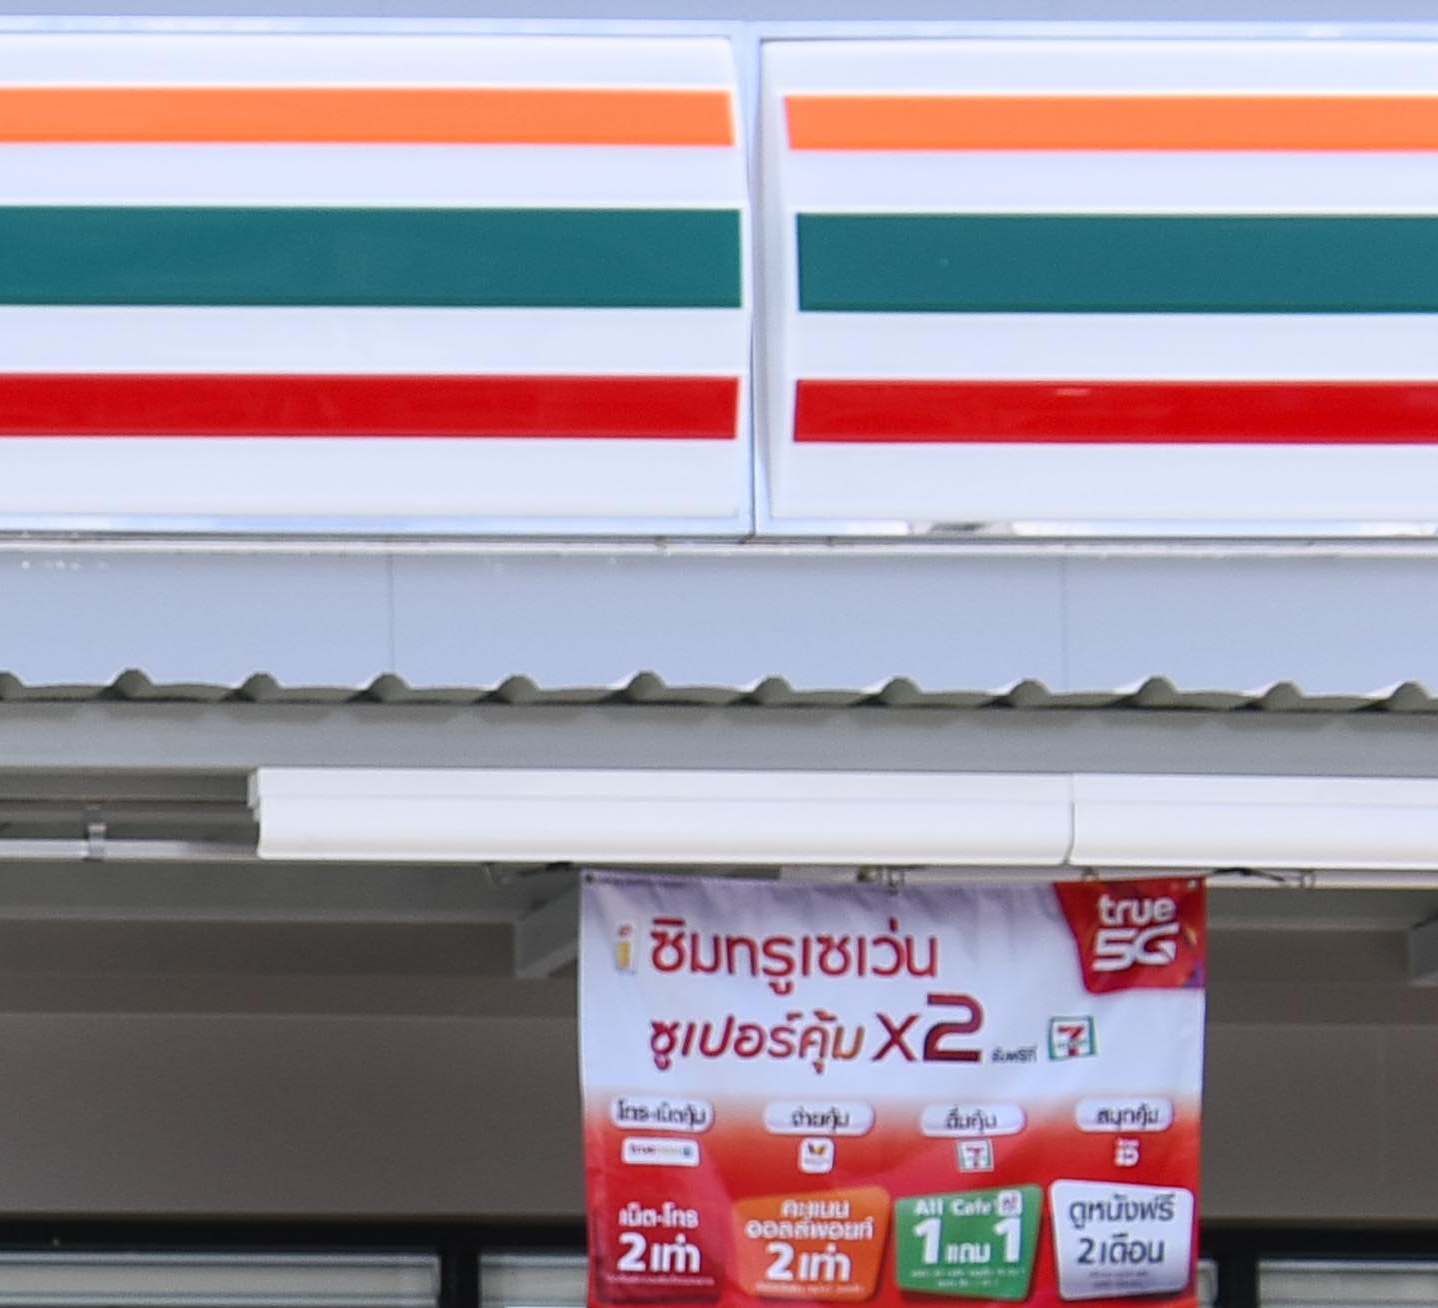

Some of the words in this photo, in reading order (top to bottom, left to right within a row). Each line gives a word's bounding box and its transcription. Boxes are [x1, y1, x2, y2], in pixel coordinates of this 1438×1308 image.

[1098, 895, 1176, 924] true
[1093, 924, 1181, 972] 5G
[914, 1217, 942, 1265] 1
[994, 1217, 1021, 1264] 1
